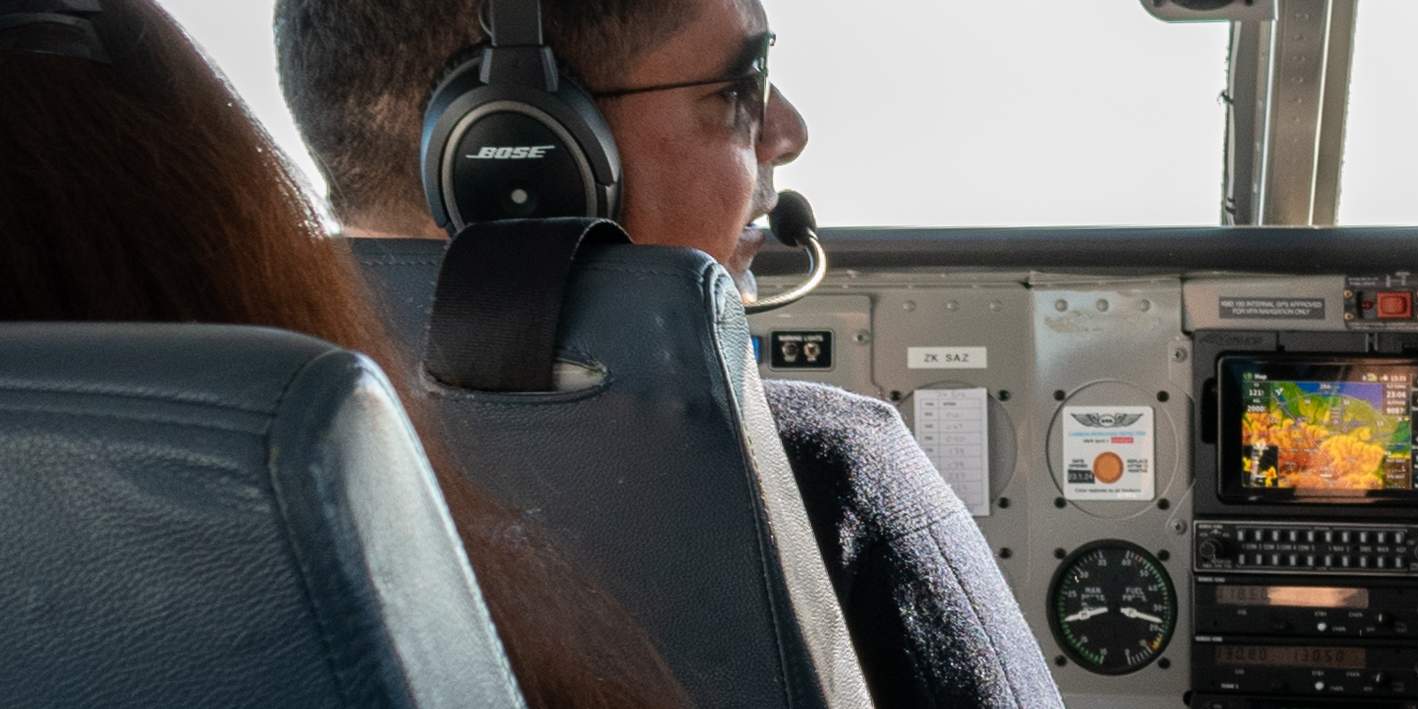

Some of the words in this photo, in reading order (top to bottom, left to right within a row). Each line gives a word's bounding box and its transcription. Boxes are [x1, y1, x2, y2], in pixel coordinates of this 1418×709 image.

[465, 145, 555, 159] BOSE
[923, 353, 938, 363] ZK
[945, 353, 969, 363] SAZ
